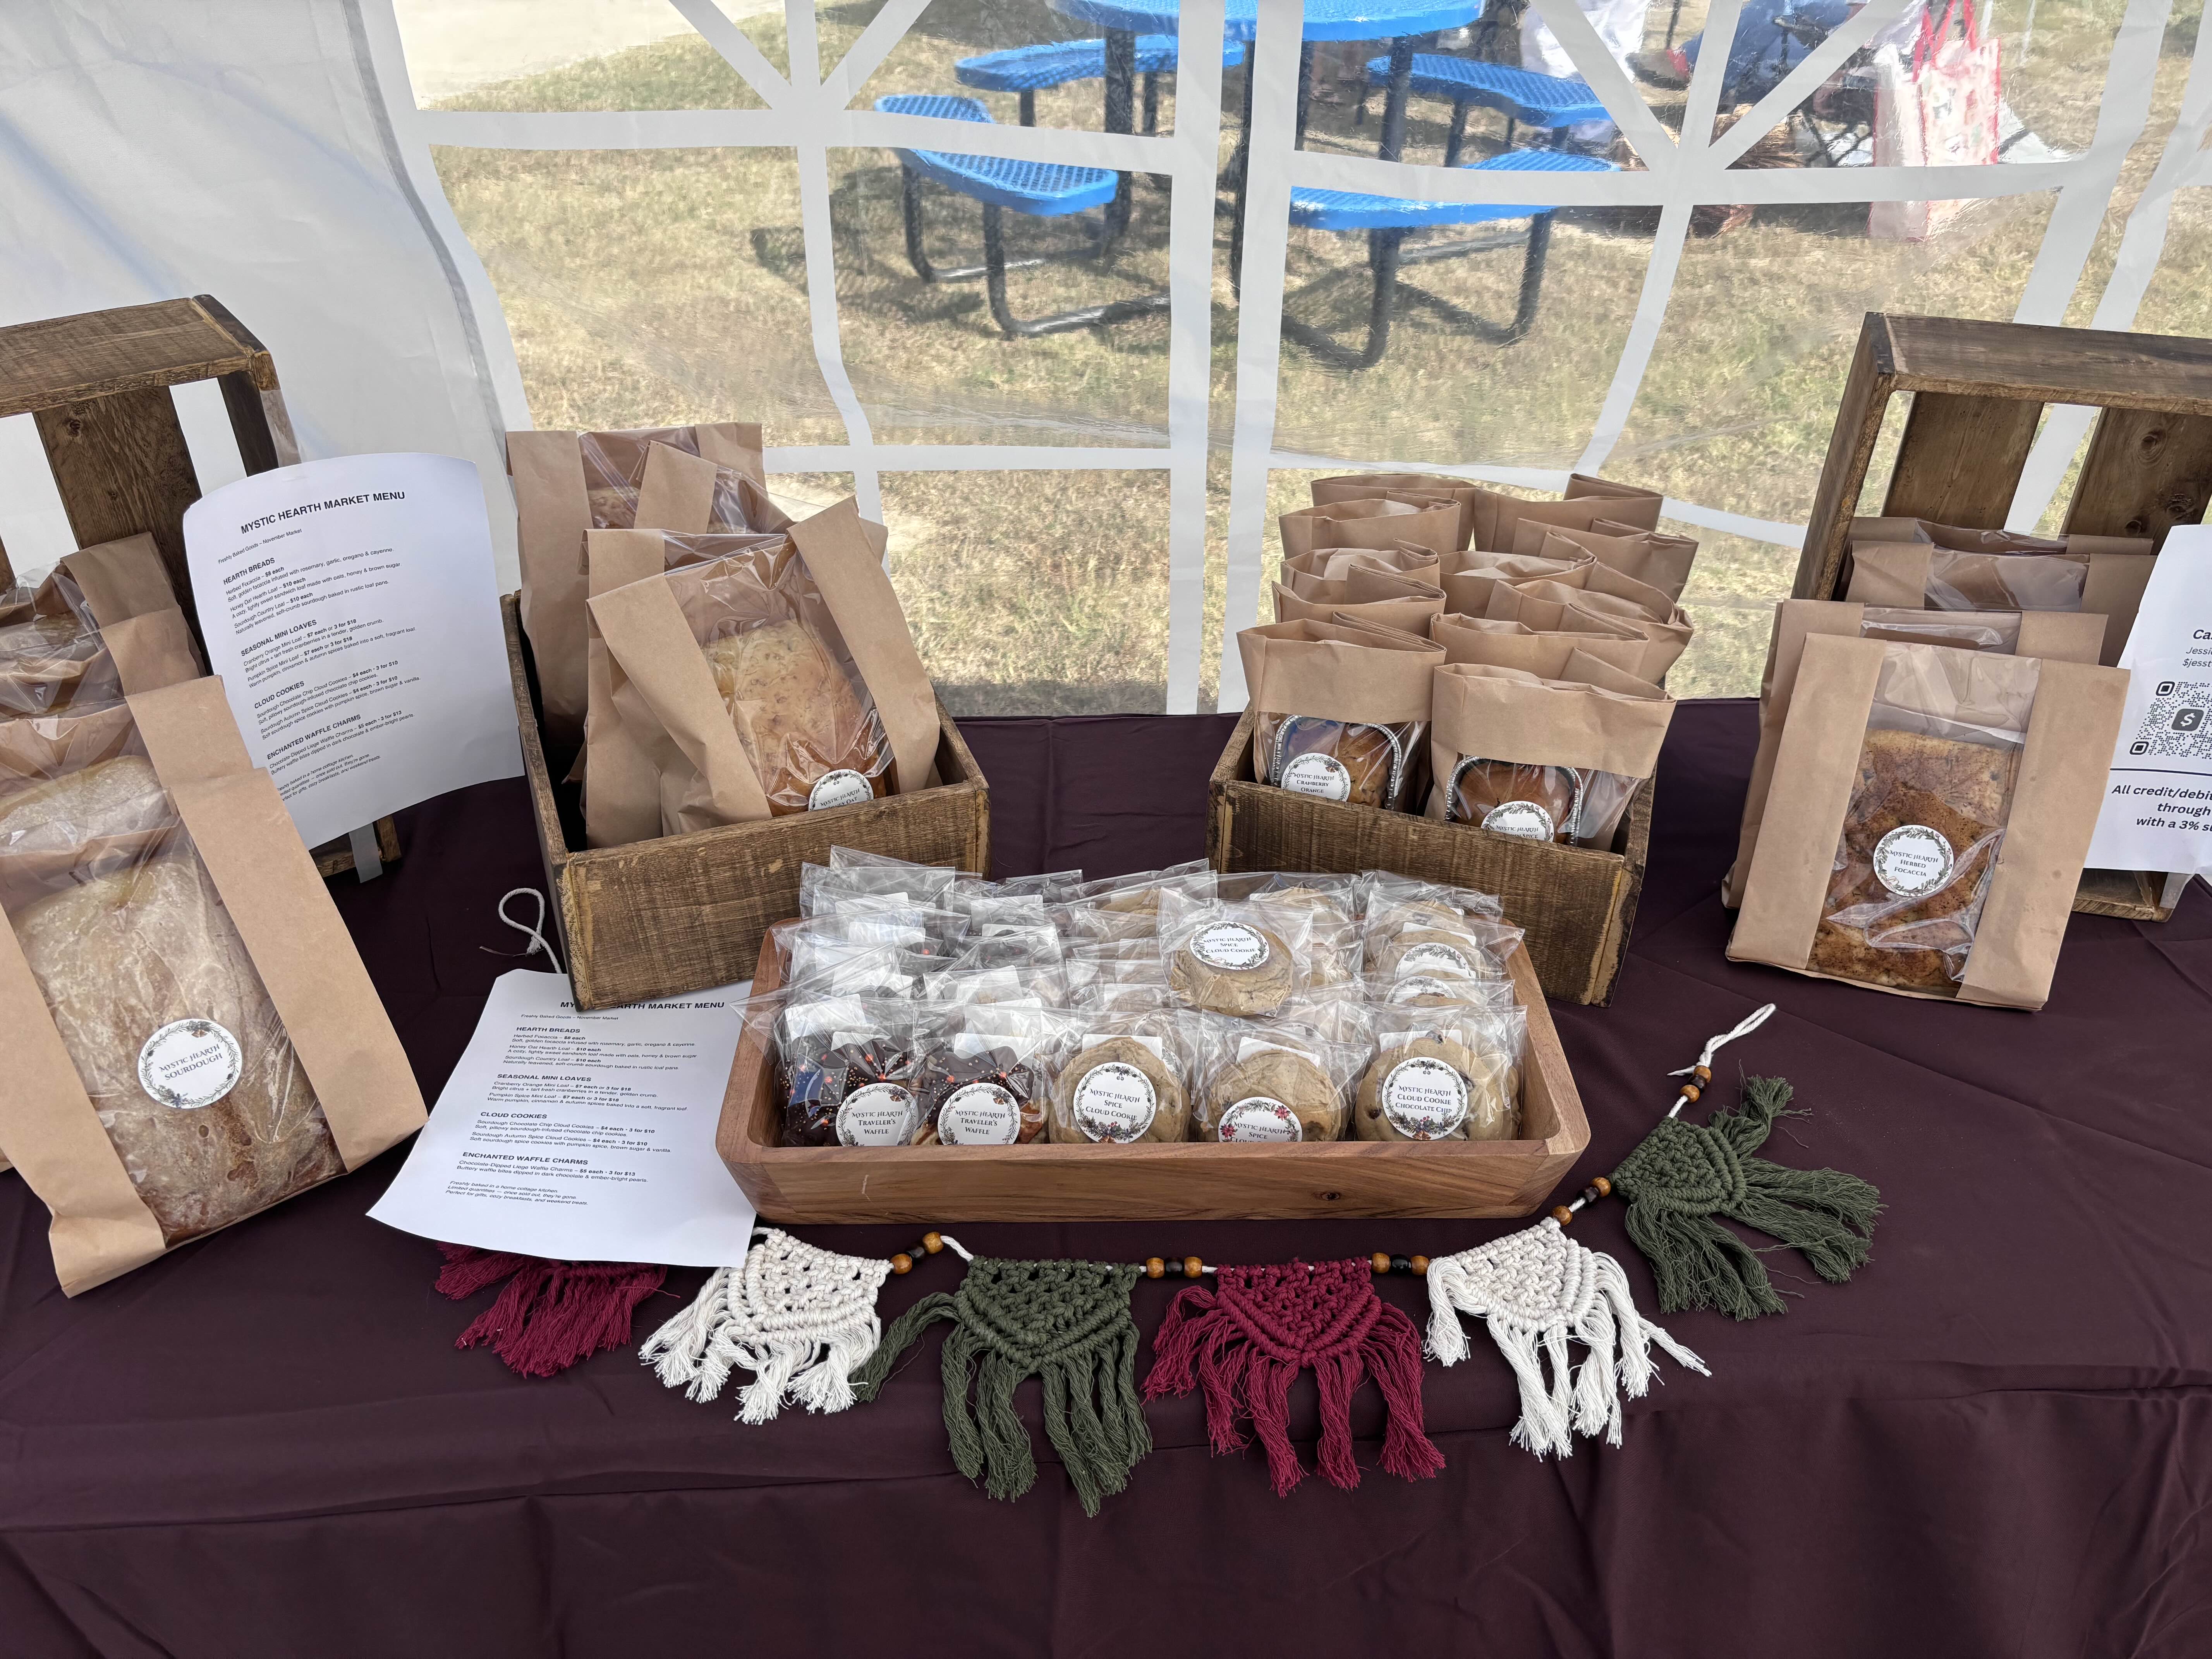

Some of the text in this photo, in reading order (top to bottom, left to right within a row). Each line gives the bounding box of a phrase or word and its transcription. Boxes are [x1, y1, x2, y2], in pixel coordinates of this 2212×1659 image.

[241, 491, 405, 534] MYSTIC HEARTH MARKET MENU
[218, 555, 232, 563] Freshly
[232, 548, 245, 557] Baked
[263, 534, 285, 544] November
[223, 558, 275, 585] HEARTH BREADS
[226, 584, 241, 595] Herbed
[242, 576, 260, 587] Focaccia
[230, 603, 243, 611] Honey
[252, 591, 267, 600] Hearth
[234, 614, 256, 628] Sourdough
[257, 606, 273, 617] Country
[241, 620, 316, 656] SEASONAL MINI LOAVES
[2193, 629, 2212, 640] Ca
[244, 653, 263, 666] Cranberry
[264, 646, 280, 655] Orange
[2186, 647, 2212, 655] Jessi
[247, 670, 265, 682] Pumpkin
[254, 681, 304, 708] CLOUD COOKIES
[267, 714, 361, 759] ENCHANTED WAFFLE CHARMS
[2111, 785, 2131, 794] All
[820, 797, 840, 806] MYSTIC
[840, 788, 860, 800] HEARTH
[2157, 803, 2211, 817] through
[2136, 817, 2165, 827] with
[2179, 821, 2200, 830] 3%
[1890, 850, 1938, 863] MYSTIC HEARTH
[1900, 859, 1926, 868] HERBED
[1894, 866, 1926, 876] FOCACCIA
[159, 1044, 220, 1072] MYSTIC HEARTH
[165, 1053, 223, 1080] SOURDOUGH
[1090, 1089, 1140, 1103] MYSTIC HEARTH
[1399, 1085, 1423, 1093] MYSTIC
[1104, 1100, 1123, 1108] SPICE
[1395, 1103, 1434, 1111] CHOCOLATE
[1086, 1106, 1137, 1120] CLOUD COOKIE
[960, 1118, 998, 1126] TRAVELER'S
[1234, 1121, 1258, 1130] MYSTIC
[965, 1127, 990, 1135] WAFFLE
[462, 1152, 514, 1160] ENCHANTED
